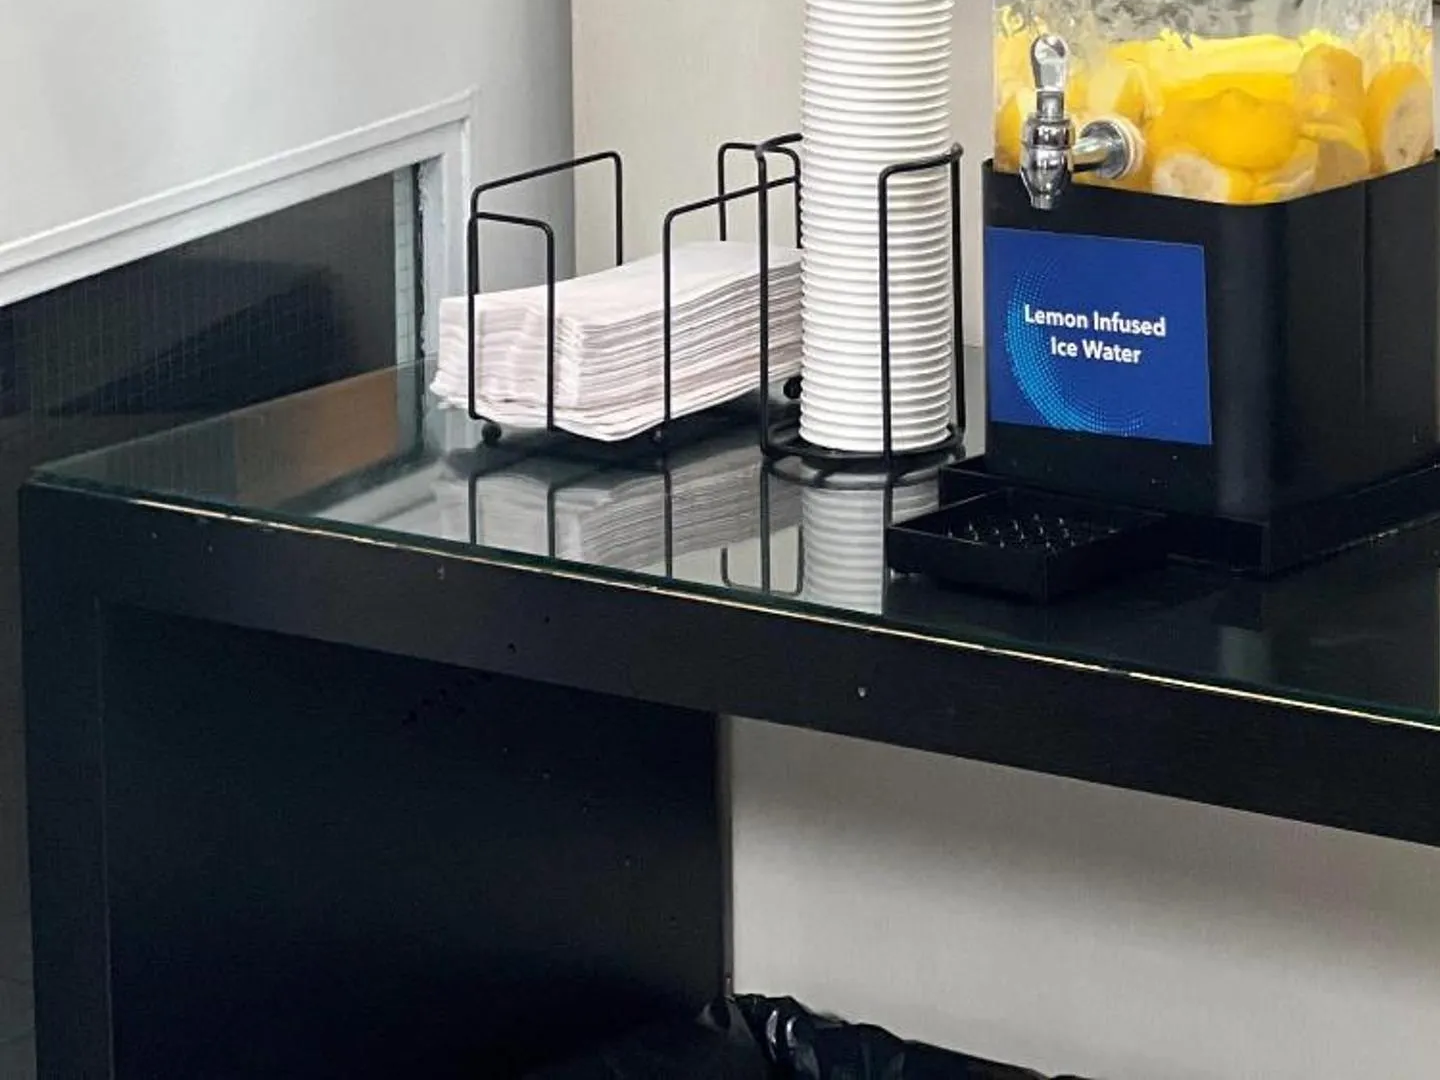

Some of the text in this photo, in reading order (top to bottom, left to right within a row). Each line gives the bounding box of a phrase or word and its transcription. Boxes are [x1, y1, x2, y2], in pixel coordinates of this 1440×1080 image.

[1024, 303, 1167, 337] Lemon Infused
[1050, 336, 1142, 364] Ice Water
